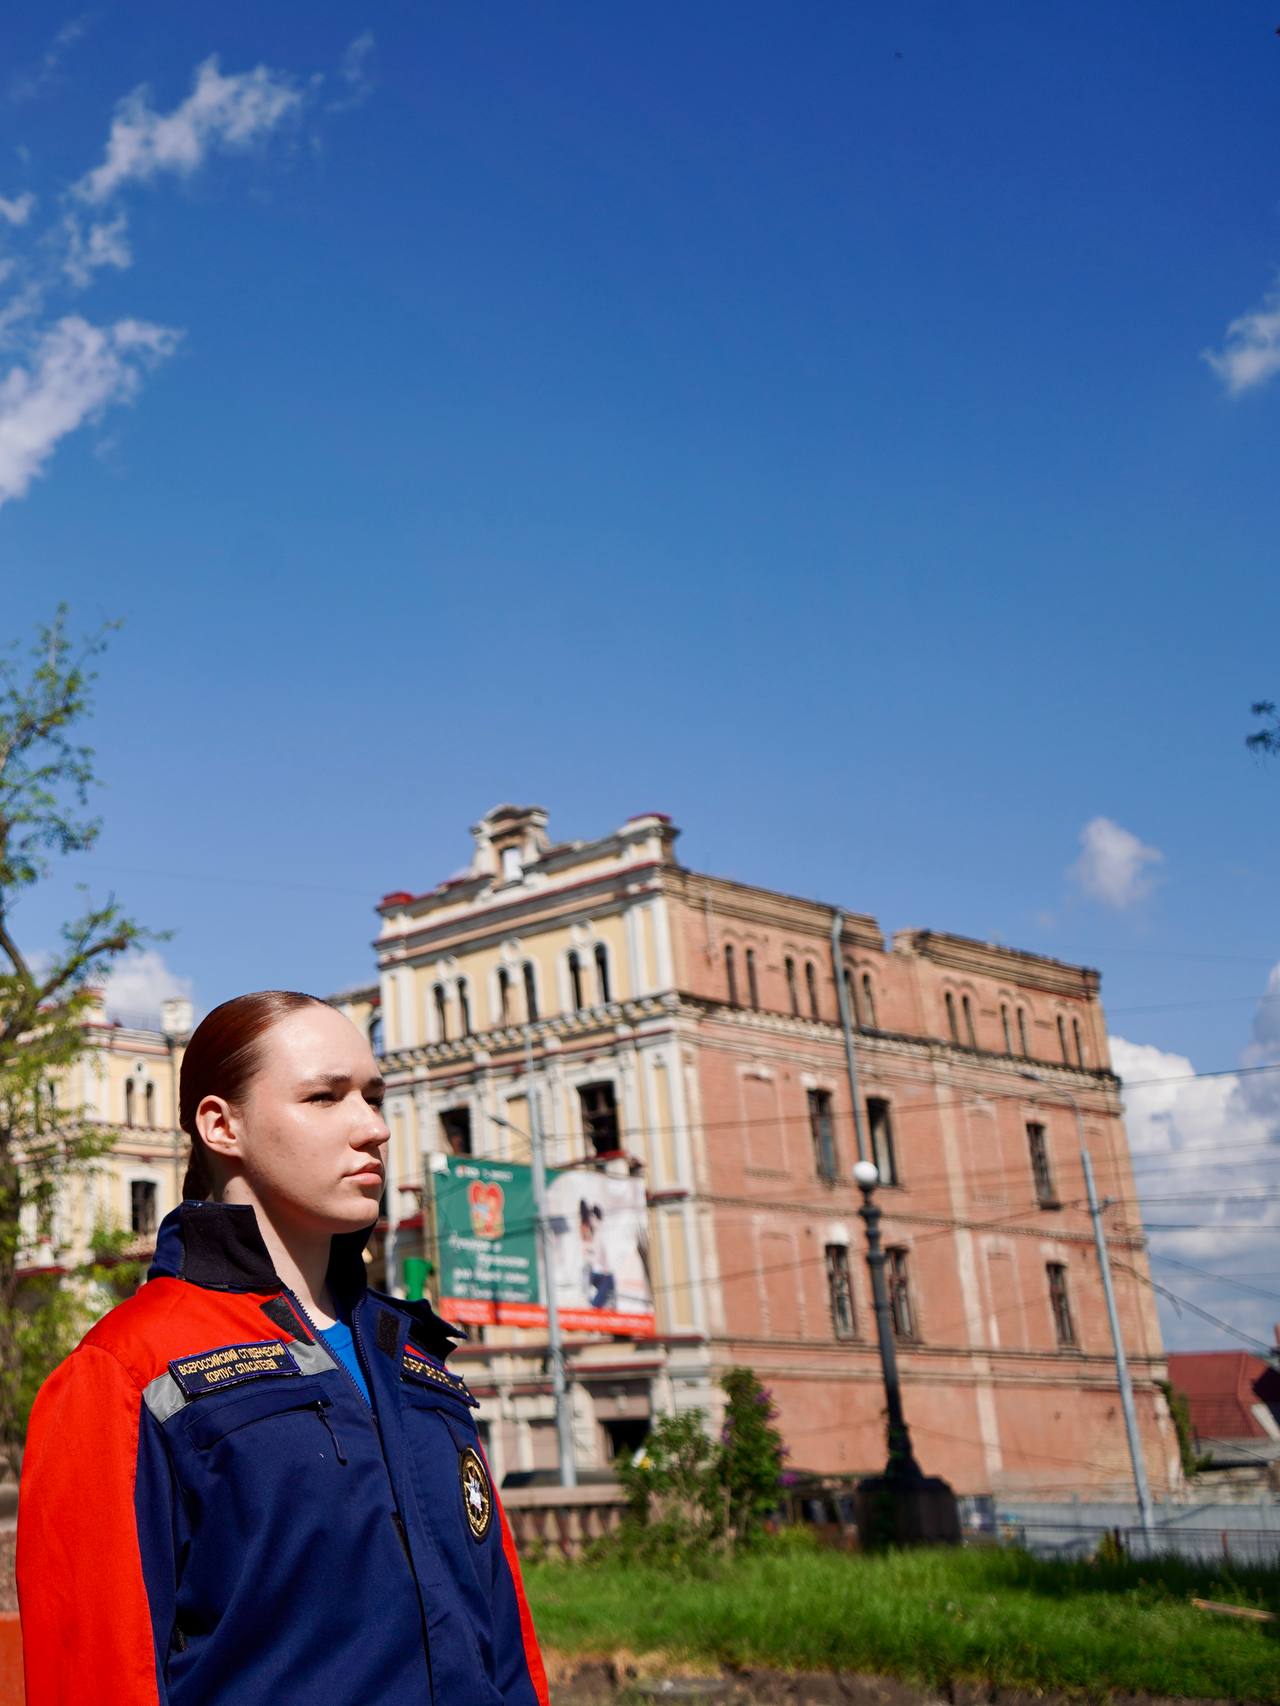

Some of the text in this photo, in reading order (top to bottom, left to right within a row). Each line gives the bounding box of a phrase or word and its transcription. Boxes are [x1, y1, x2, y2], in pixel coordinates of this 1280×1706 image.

[178, 1343, 285, 1375] ВСЕРОССИЙСКИЙ СТУДЕНЧЕСКИЙ
[204, 1358, 278, 1383] КОРПУС СПАСАТЕЛЕЙ
